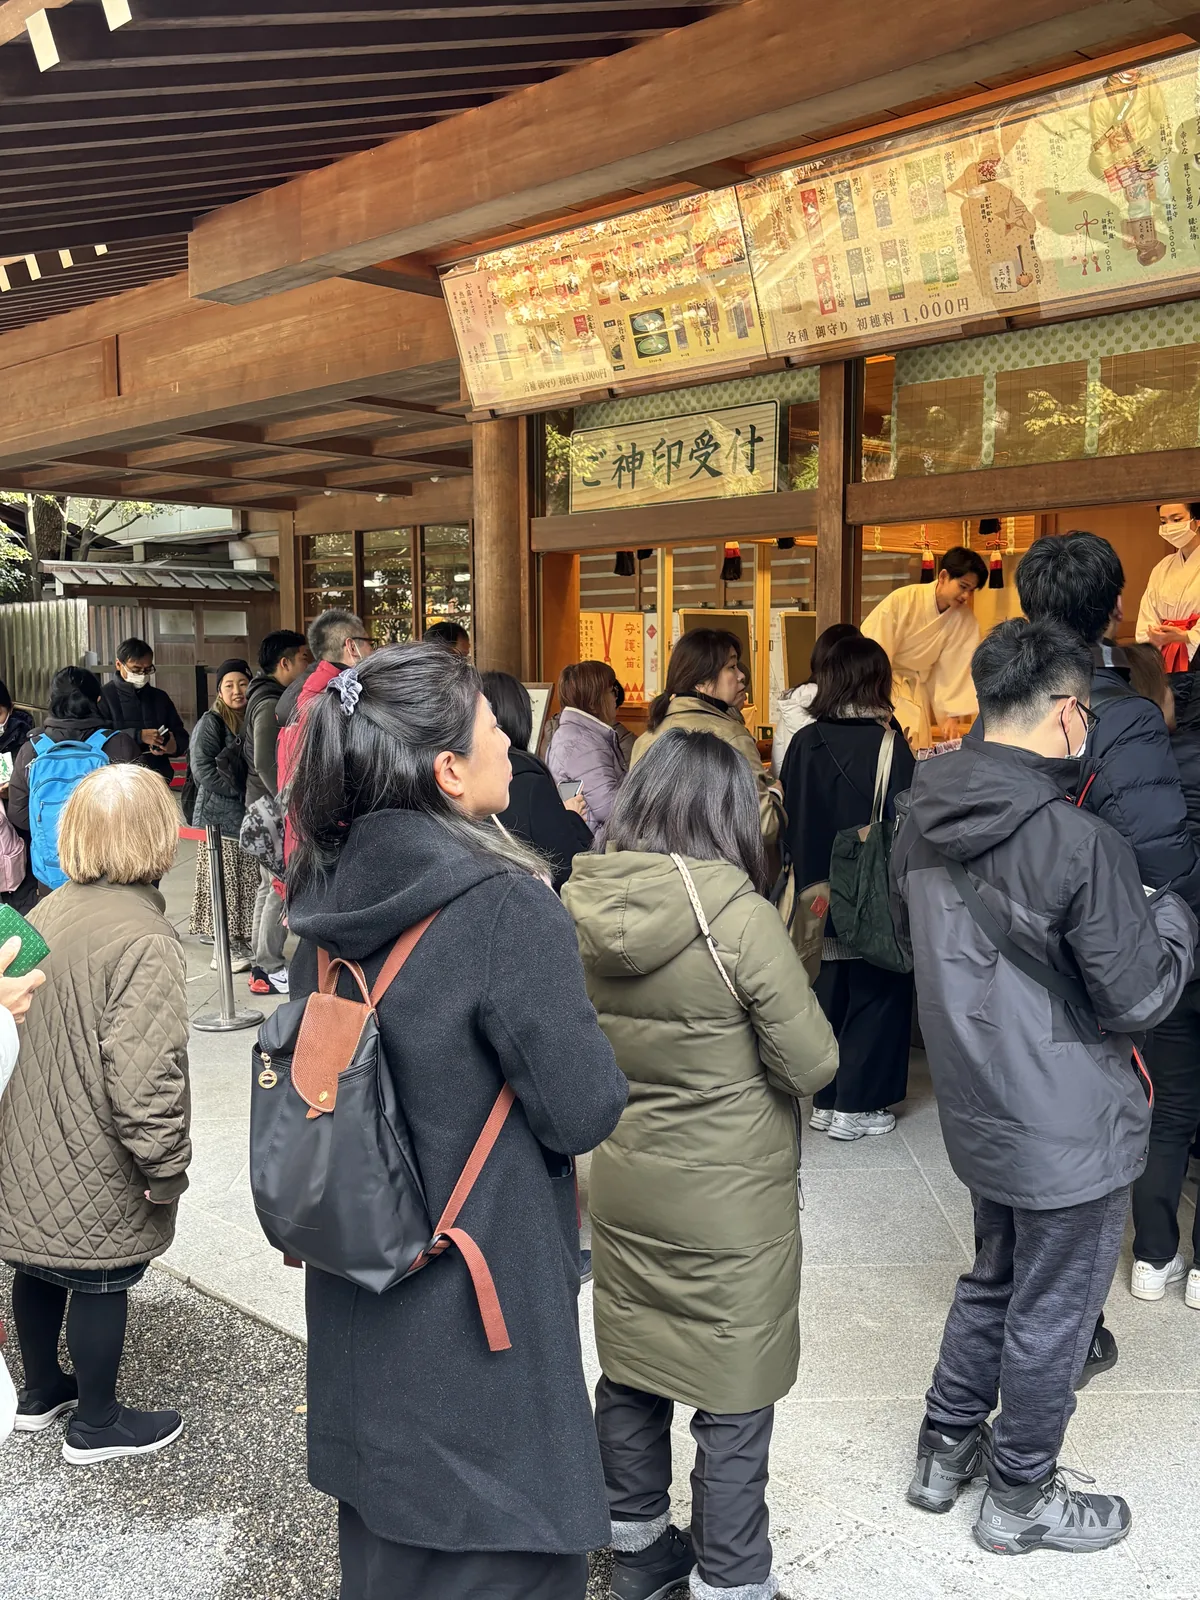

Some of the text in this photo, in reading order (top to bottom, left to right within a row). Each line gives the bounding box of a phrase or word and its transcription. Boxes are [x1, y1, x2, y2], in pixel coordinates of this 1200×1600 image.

[818, 186, 827, 206] 女守
[786, 296, 970, 345] 各種 御守り 初穂料 1,000円
[580, 367, 608, 383] 1,000円
[581, 423, 764, 490] ご神印受付
[624, 621, 636, 669] 守護笛
